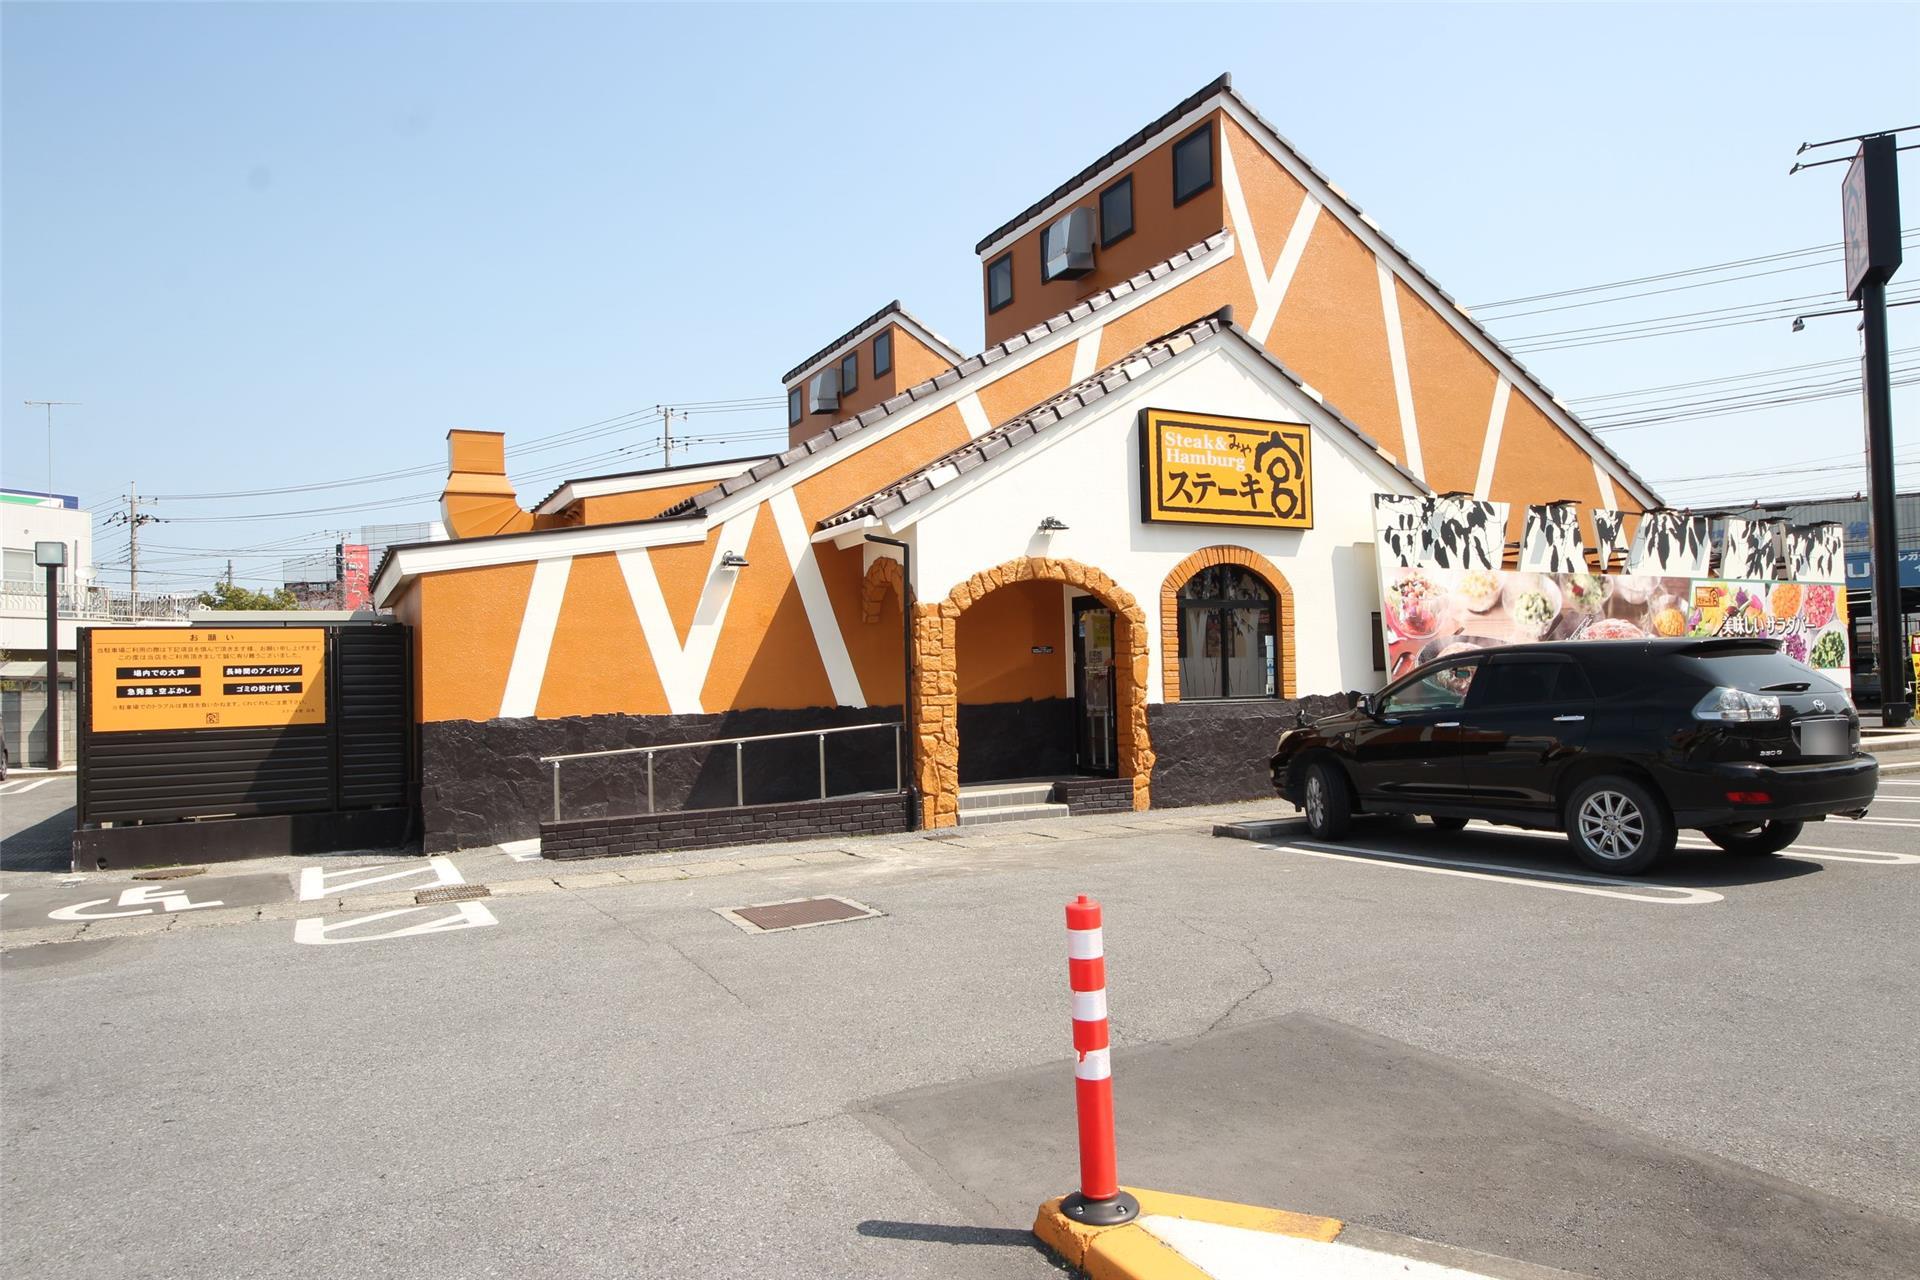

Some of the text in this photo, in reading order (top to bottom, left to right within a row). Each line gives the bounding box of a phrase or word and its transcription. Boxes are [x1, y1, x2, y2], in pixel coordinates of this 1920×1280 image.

[1165, 432, 1227, 451] Steak&
[1166, 448, 1246, 472] Hamburg
[133, 669, 185, 677] 場内での大声
[226, 667, 300, 676] 長時間のアイドリング
[236, 685, 290, 693] ゴミの投げ捨て
